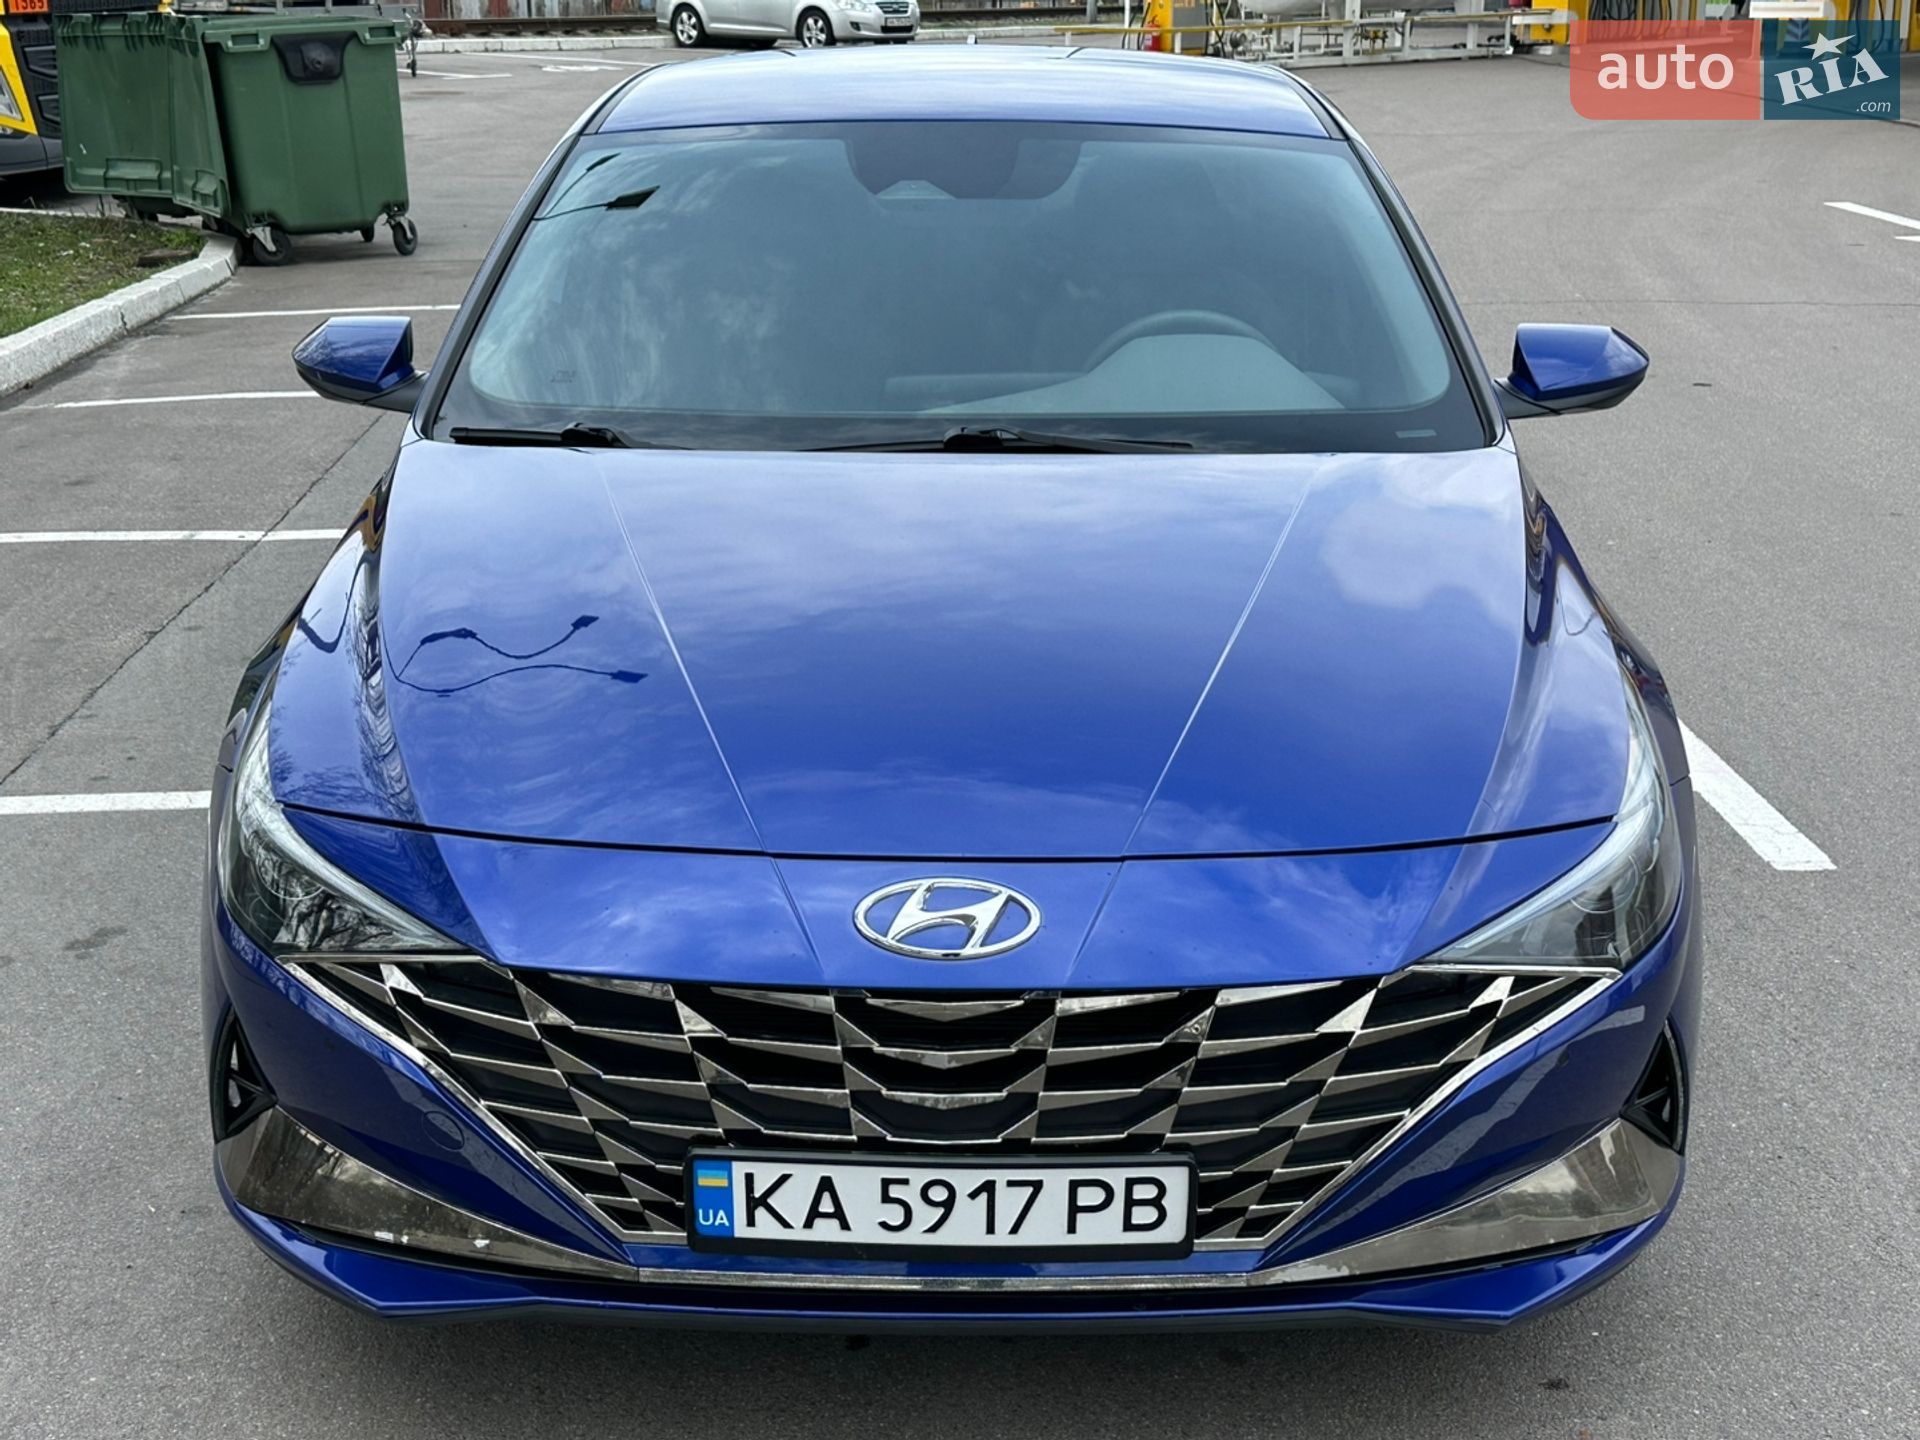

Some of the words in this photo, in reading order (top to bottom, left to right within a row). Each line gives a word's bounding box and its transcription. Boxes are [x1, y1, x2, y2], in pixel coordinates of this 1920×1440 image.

[698, 1208, 730, 1227] UA
[744, 1172, 852, 1232] KA
[877, 1177, 1044, 1236] 5917
[1066, 1176, 1168, 1235] PB
